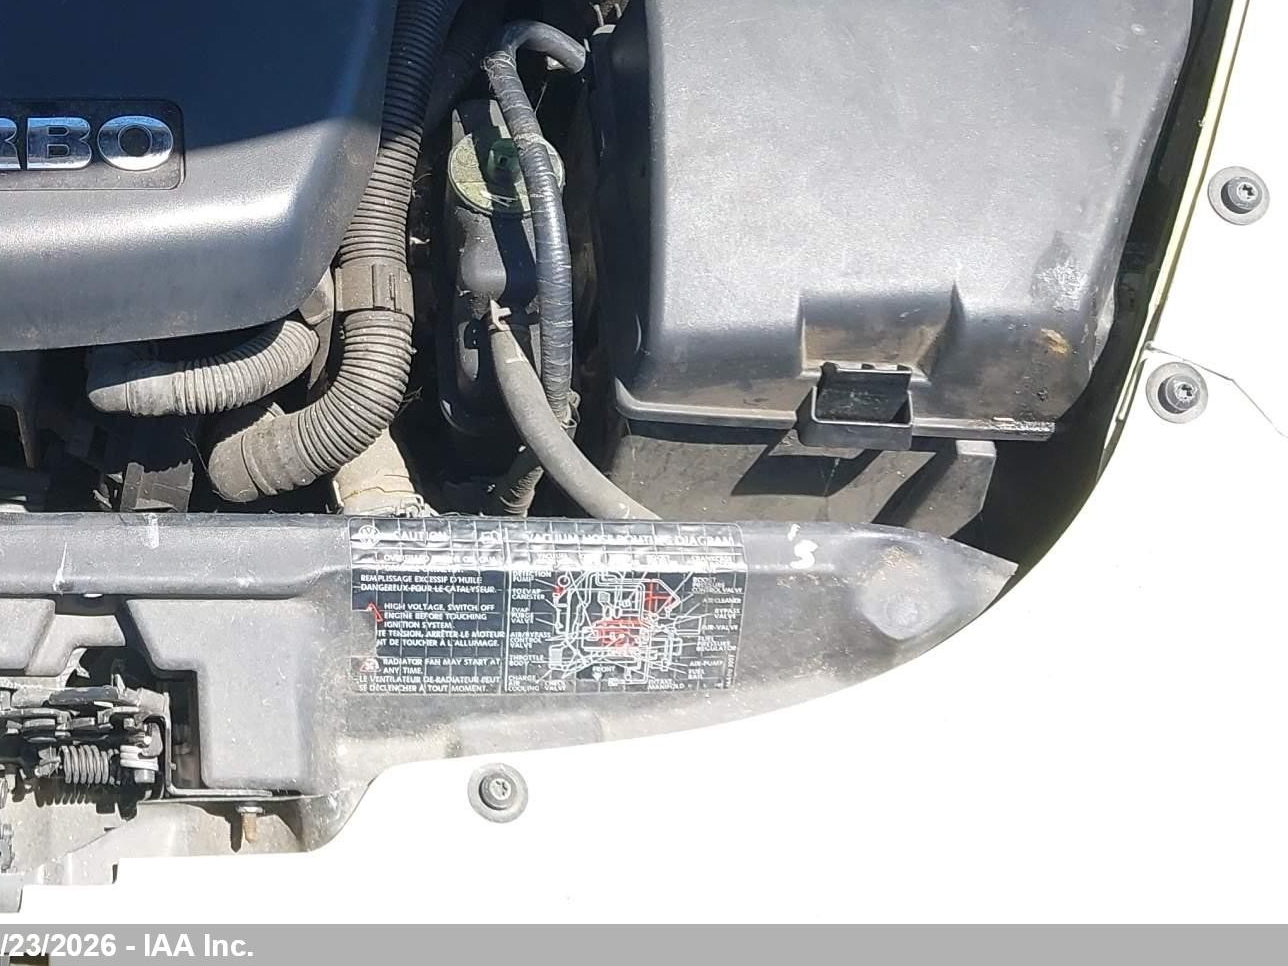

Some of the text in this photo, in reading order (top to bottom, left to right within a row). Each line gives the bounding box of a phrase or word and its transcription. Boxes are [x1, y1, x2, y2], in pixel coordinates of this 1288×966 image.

[361, 575, 413, 583] REMPLISSAGE
[361, 584, 406, 592] DANGEREUX
[384, 603, 405, 611] HIGH
[384, 612, 413, 620] ENGINE
[415, 612, 443, 620] BEFORE
[384, 621, 455, 629] IGNITION SYSTEM.
[383, 658, 422, 666] RADIATOR
[425, 658, 440, 666] FAN
[383, 667, 423, 675] ANY TIME.
[359, 675, 367, 683] LE
[369, 676, 422, 684] VENTILATEUR
[481, 676, 500, 684] PEUT
